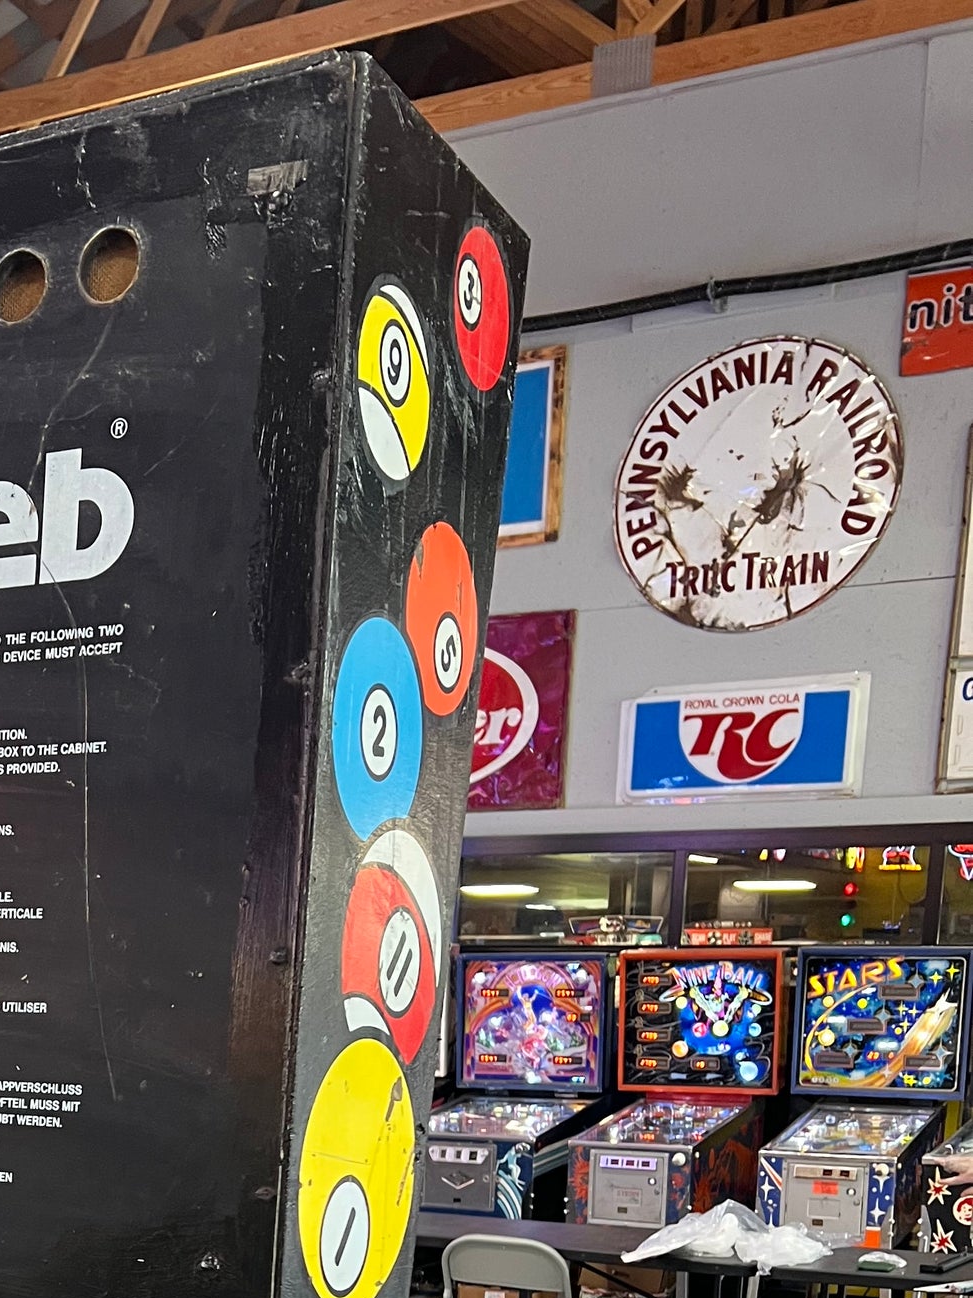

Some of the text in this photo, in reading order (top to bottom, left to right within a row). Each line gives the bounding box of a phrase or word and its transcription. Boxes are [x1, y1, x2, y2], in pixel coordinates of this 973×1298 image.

[463, 275, 477, 309] 3
[387, 338, 402, 378] 9
[627, 350, 890, 560] PENNSYLVANIA RAILROAD
[3, 648, 42, 663] DEVICE
[45, 646, 76, 659] MUST
[78, 642, 122, 657] ACCEPT
[5, 632, 27, 646] THE
[30, 626, 94, 643] FOLLOWING
[98, 624, 123, 638] TWO
[442, 633, 457, 668] 5
[684, 692, 800, 709] ROYAL CROWN COLA
[372, 705, 387, 757] 2
[683, 709, 800, 780] RC
[672, 964, 715, 989] NINE
[719, 961, 763, 990] BALL
[807, 956, 904, 999] STARS
